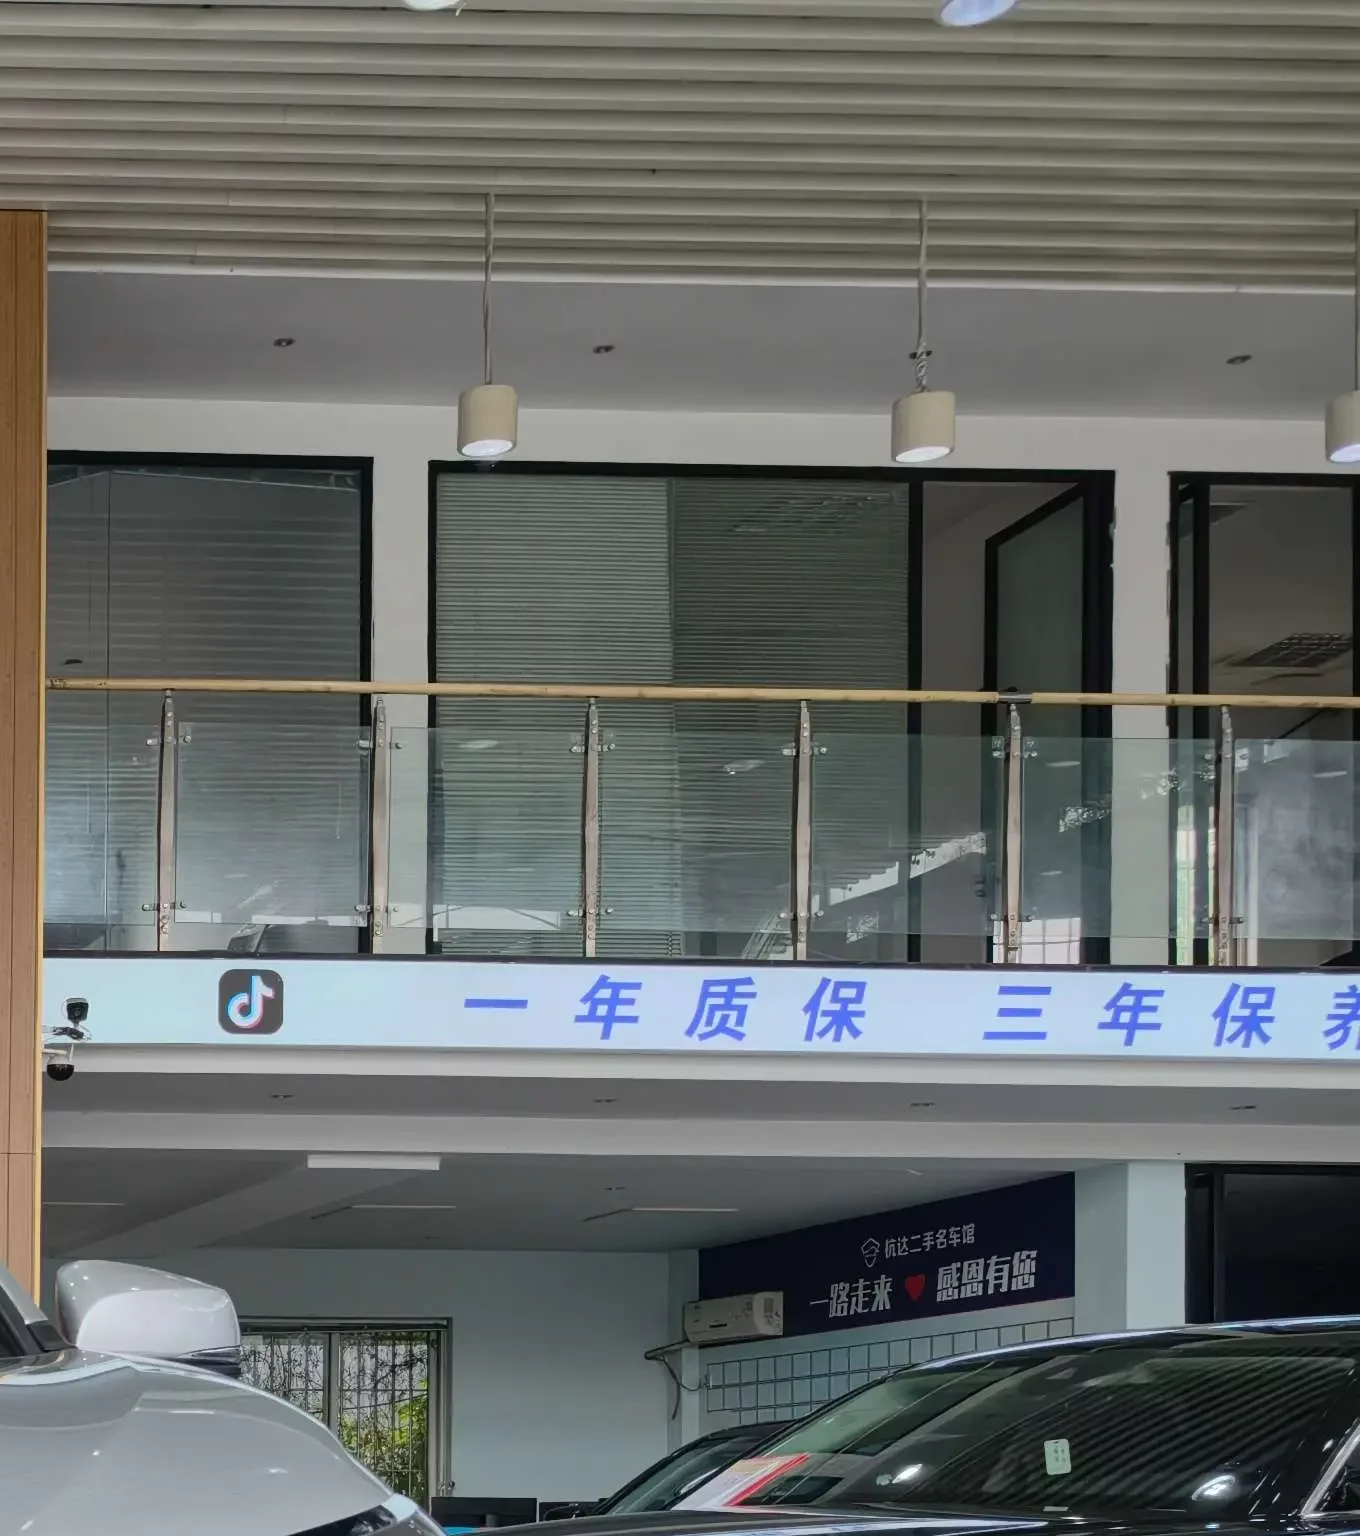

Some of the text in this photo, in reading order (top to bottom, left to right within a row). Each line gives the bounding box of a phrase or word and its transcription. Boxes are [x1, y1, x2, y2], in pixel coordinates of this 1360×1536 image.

[463, 976, 870, 1044] 一年质保
[884, 1222, 976, 1260] 杭达二手名车馆
[809, 1249, 1039, 1319] 一路走来 感恩有您
